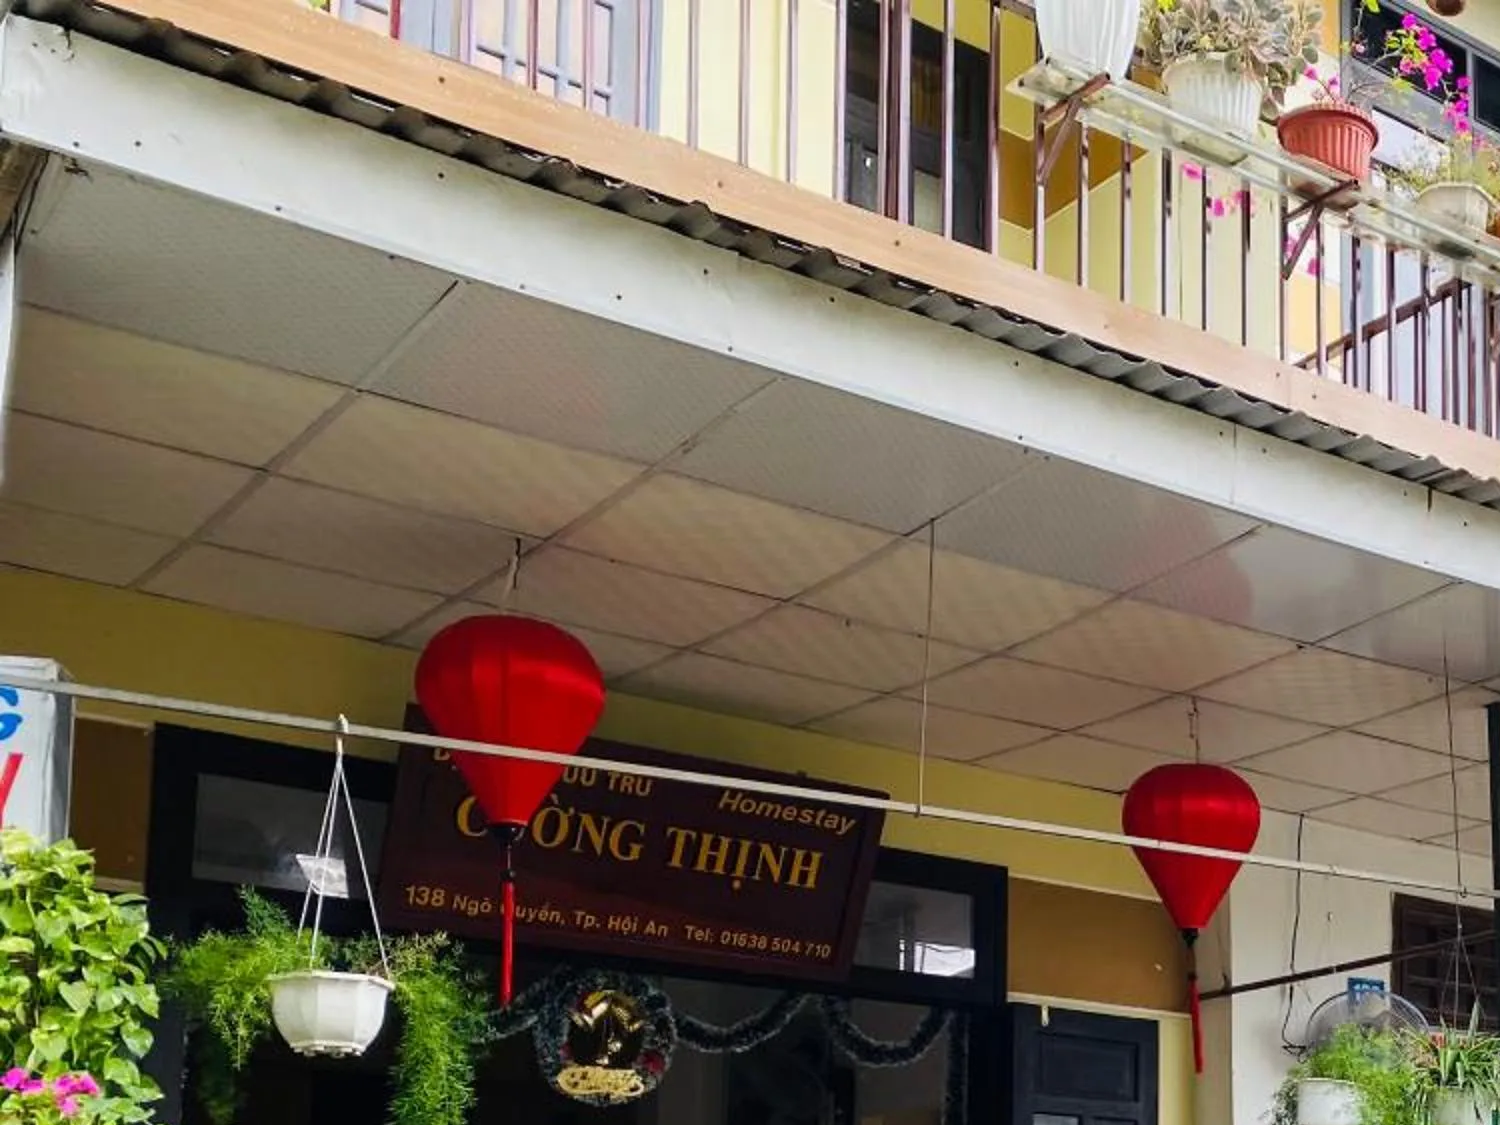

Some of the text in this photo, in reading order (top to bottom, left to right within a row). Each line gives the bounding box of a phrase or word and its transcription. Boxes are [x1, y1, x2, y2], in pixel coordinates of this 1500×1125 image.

[456, 793, 823, 890] CỜNG THỊNH
[718, 790, 858, 835] Homestay
[405, 885, 446, 907] 138
[575, 910, 601, 930] Tp.
[607, 914, 638, 936] Hội
[644, 920, 669, 938] An
[806, 943, 832, 960] 710
